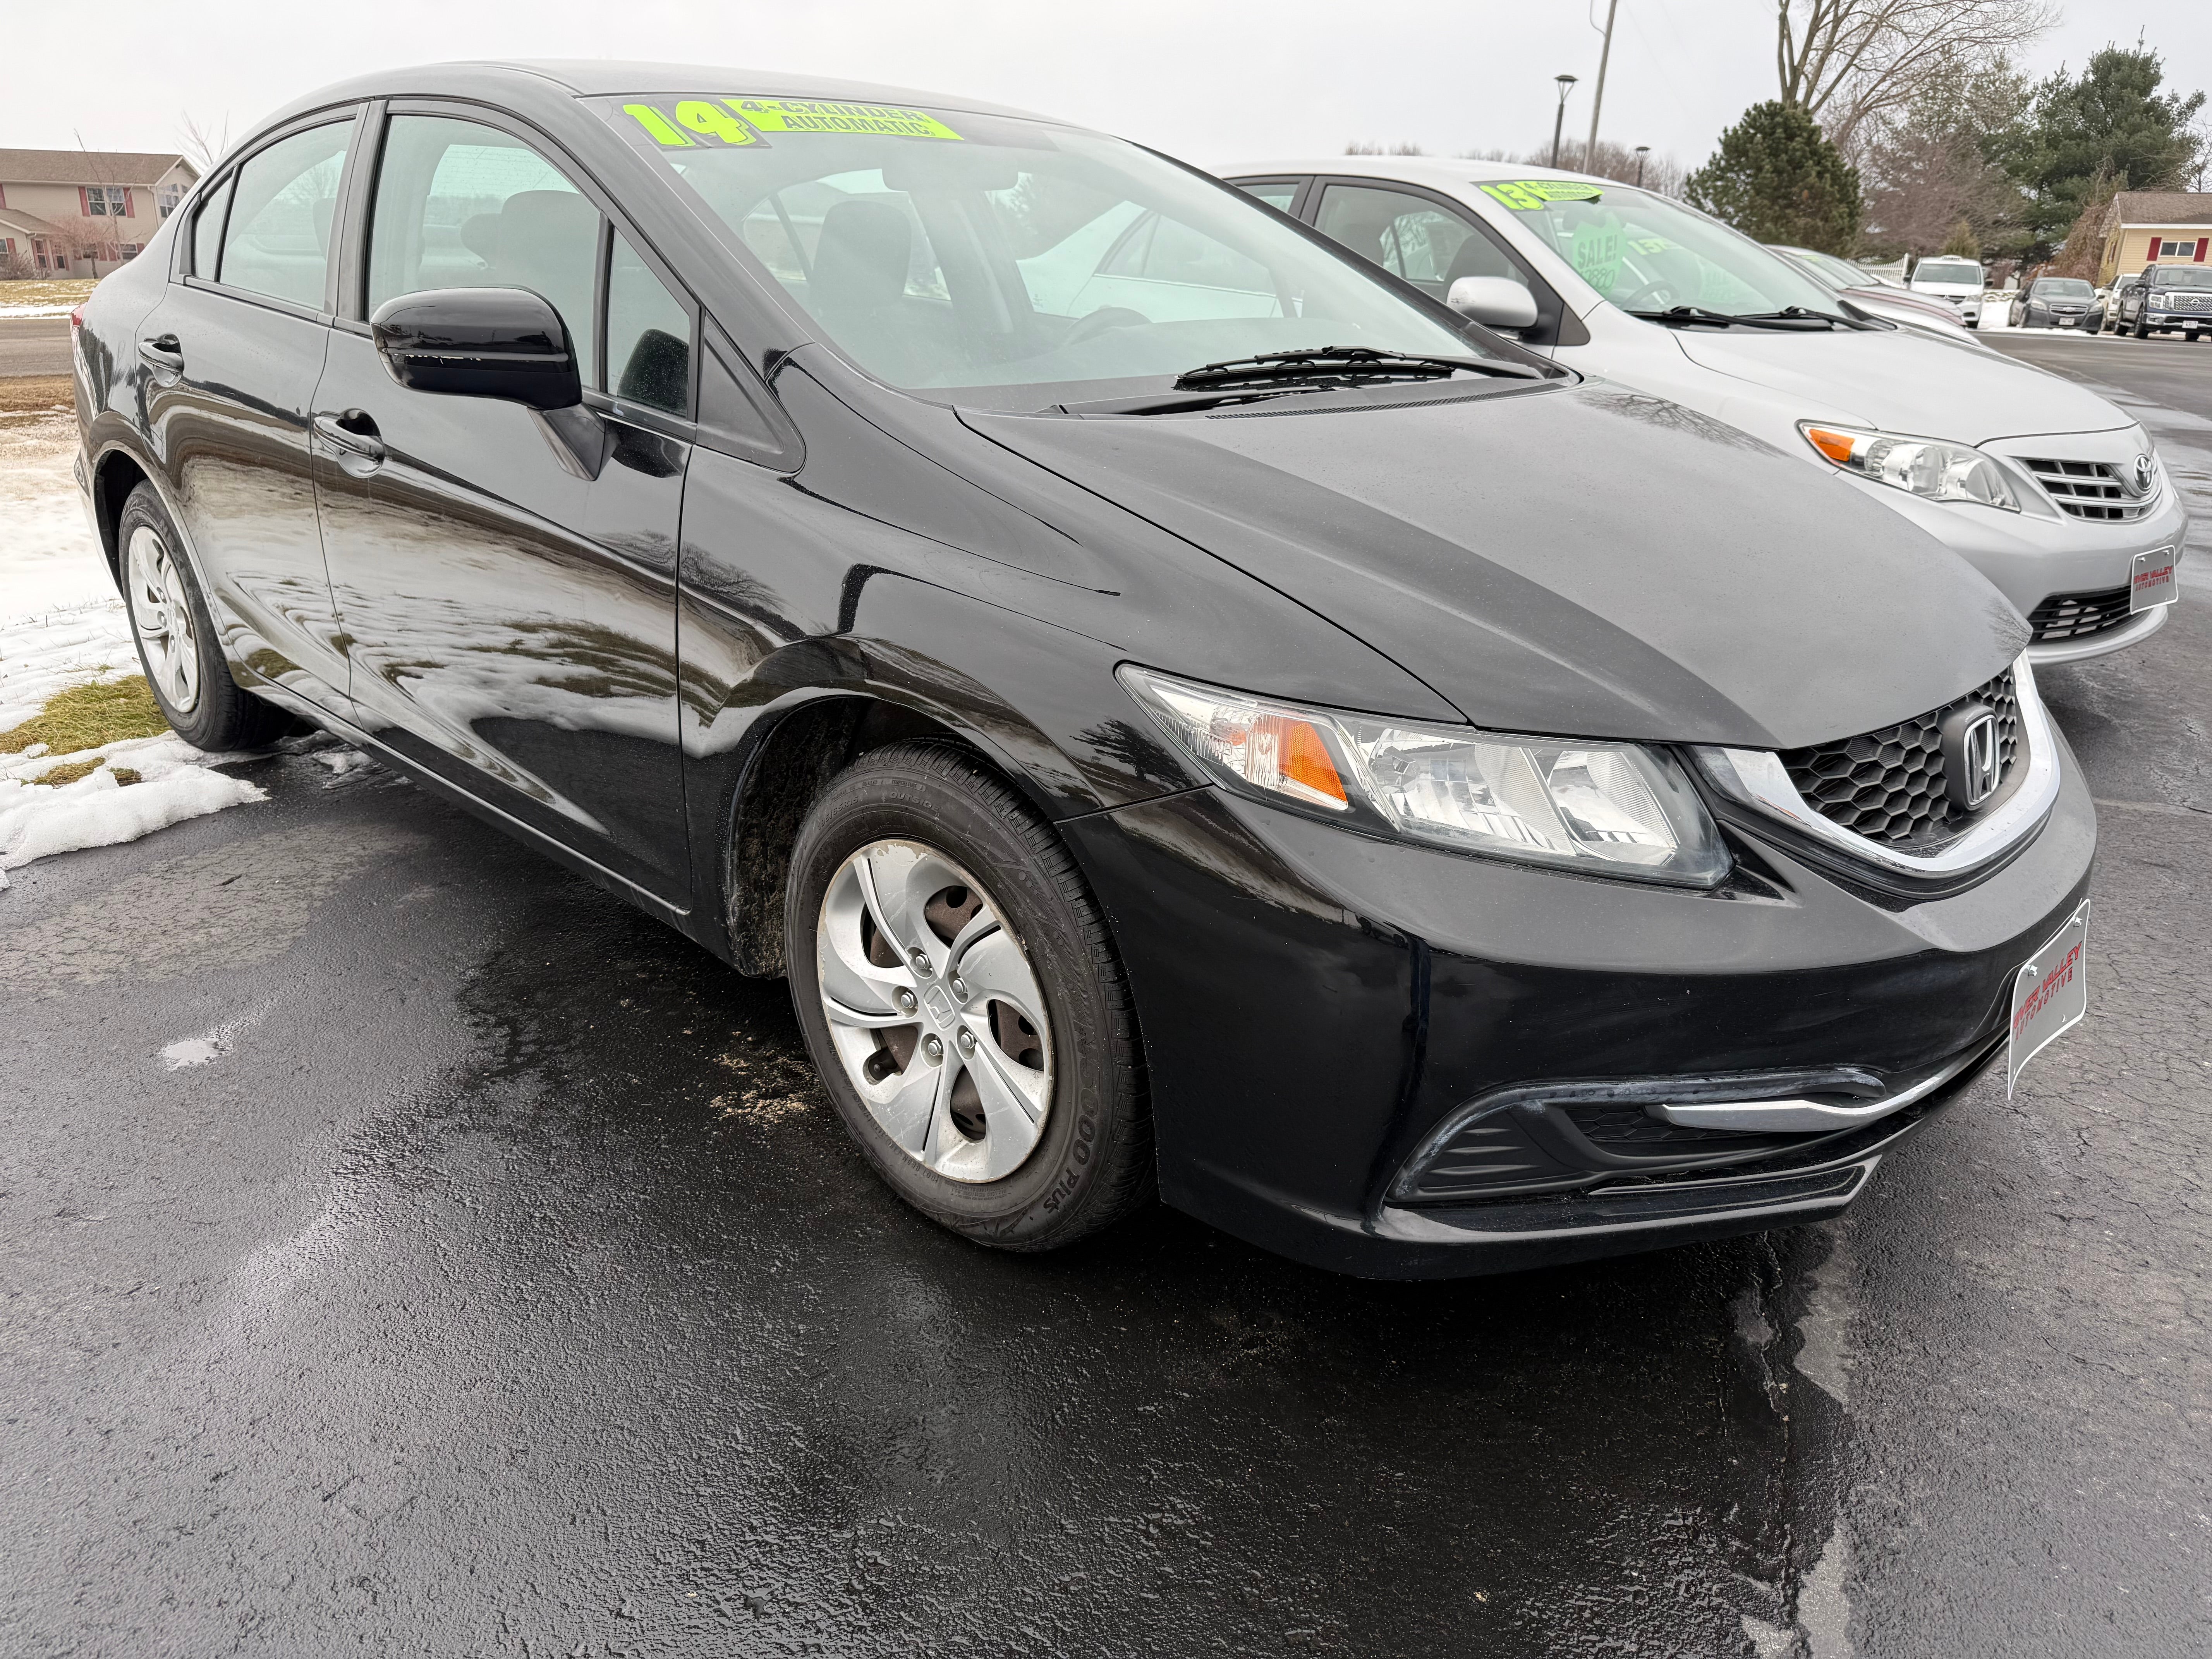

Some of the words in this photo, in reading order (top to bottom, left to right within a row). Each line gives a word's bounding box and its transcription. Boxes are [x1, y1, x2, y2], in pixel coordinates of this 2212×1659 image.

[623, 101, 755, 146] 14
[740, 100, 928, 123] 4-CYLINDER
[781, 115, 934, 136] AUTOMATIC
[1479, 184, 1544, 210] 13
[1578, 234, 1617, 270] SALE!
[2135, 575, 2169, 591] AUTOMOTIVE
[2150, 565, 2173, 579] VALLEY
[890, 792, 940, 811] OUTSIDE
[2042, 941, 2082, 994] VALLEY
[2015, 967, 2073, 1044] AUTOMOTIVE
[1044, 1167, 1080, 1214] Plus
